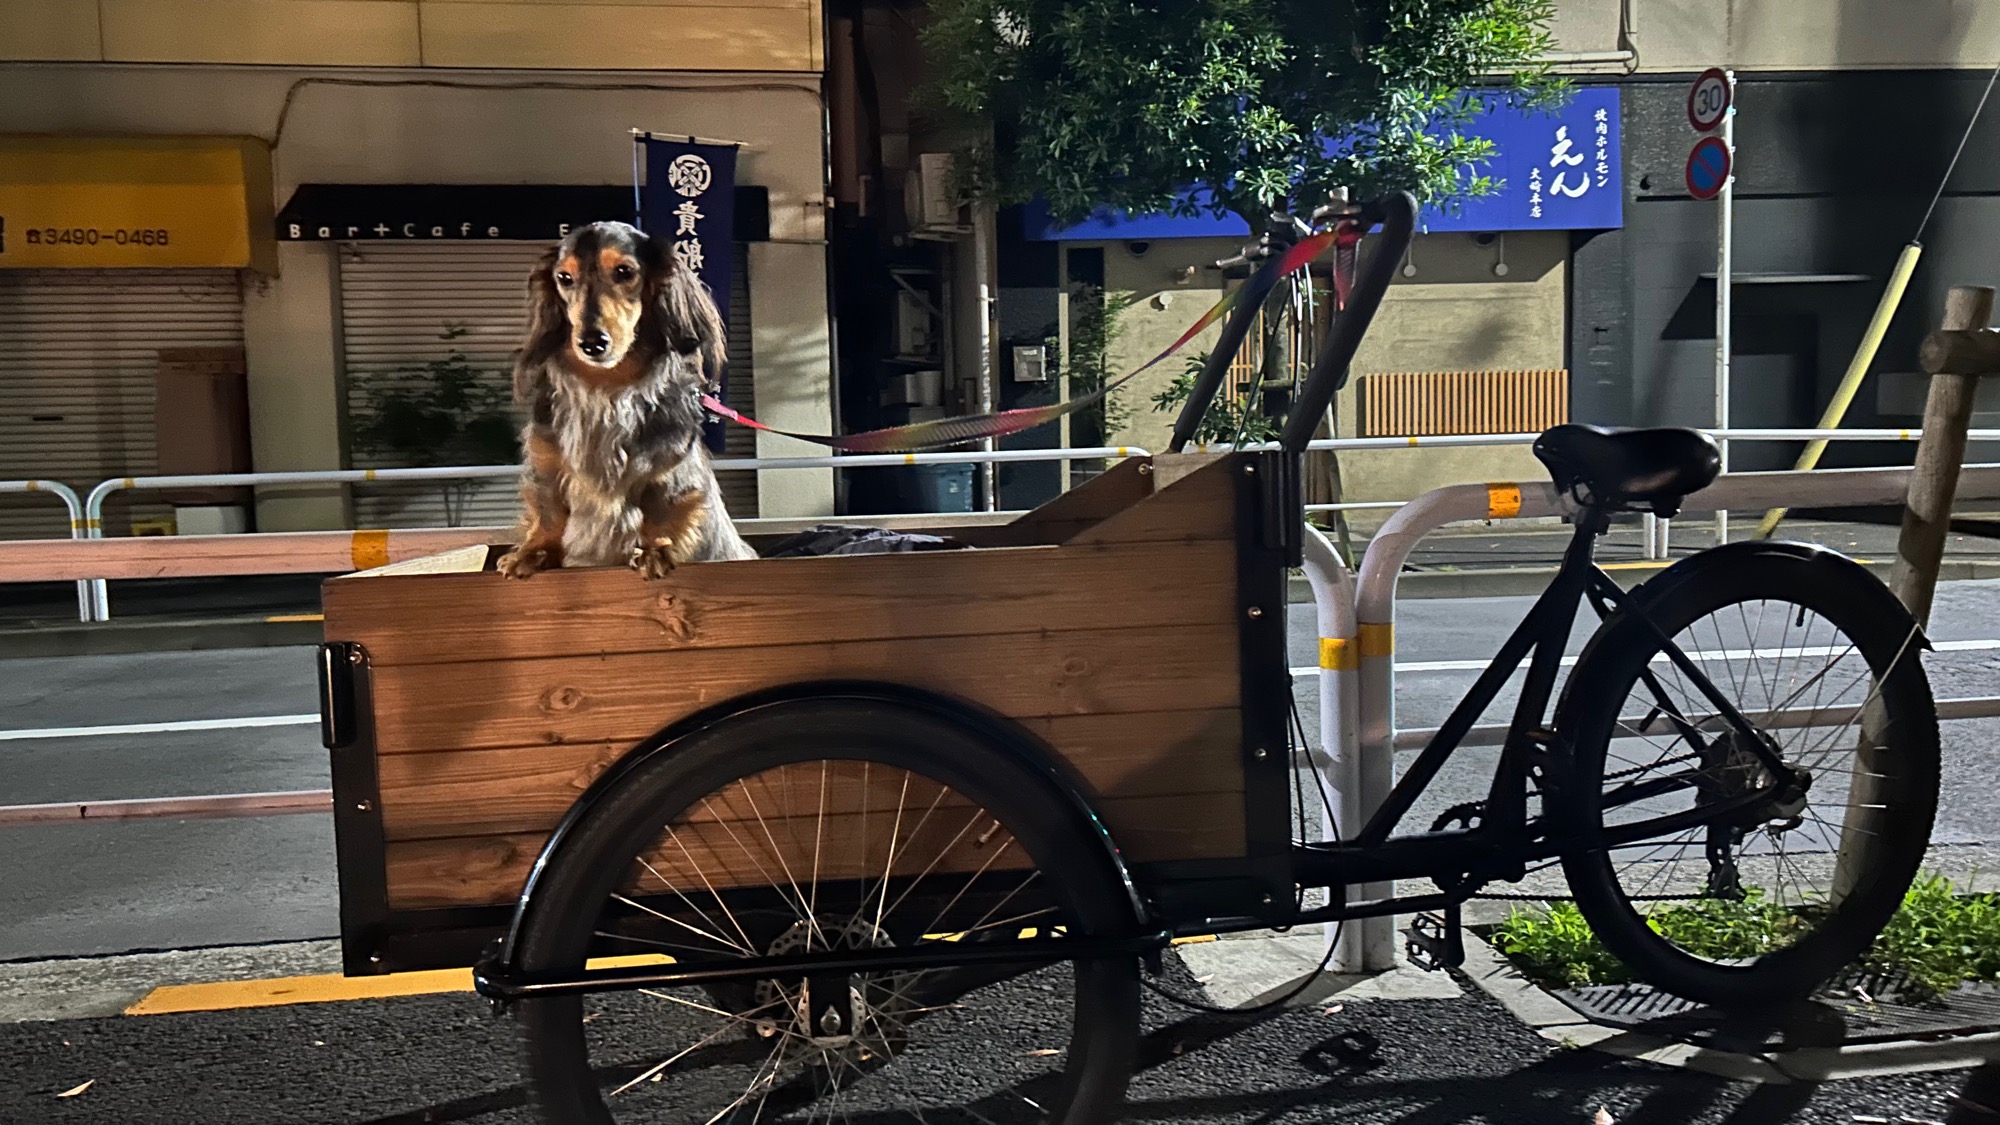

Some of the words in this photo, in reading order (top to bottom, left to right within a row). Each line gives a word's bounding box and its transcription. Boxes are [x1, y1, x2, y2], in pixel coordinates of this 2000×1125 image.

[1697, 85, 1721, 116] 30
[1549, 125, 1590, 198] えん
[45, 228, 169, 246] 3490-0468
